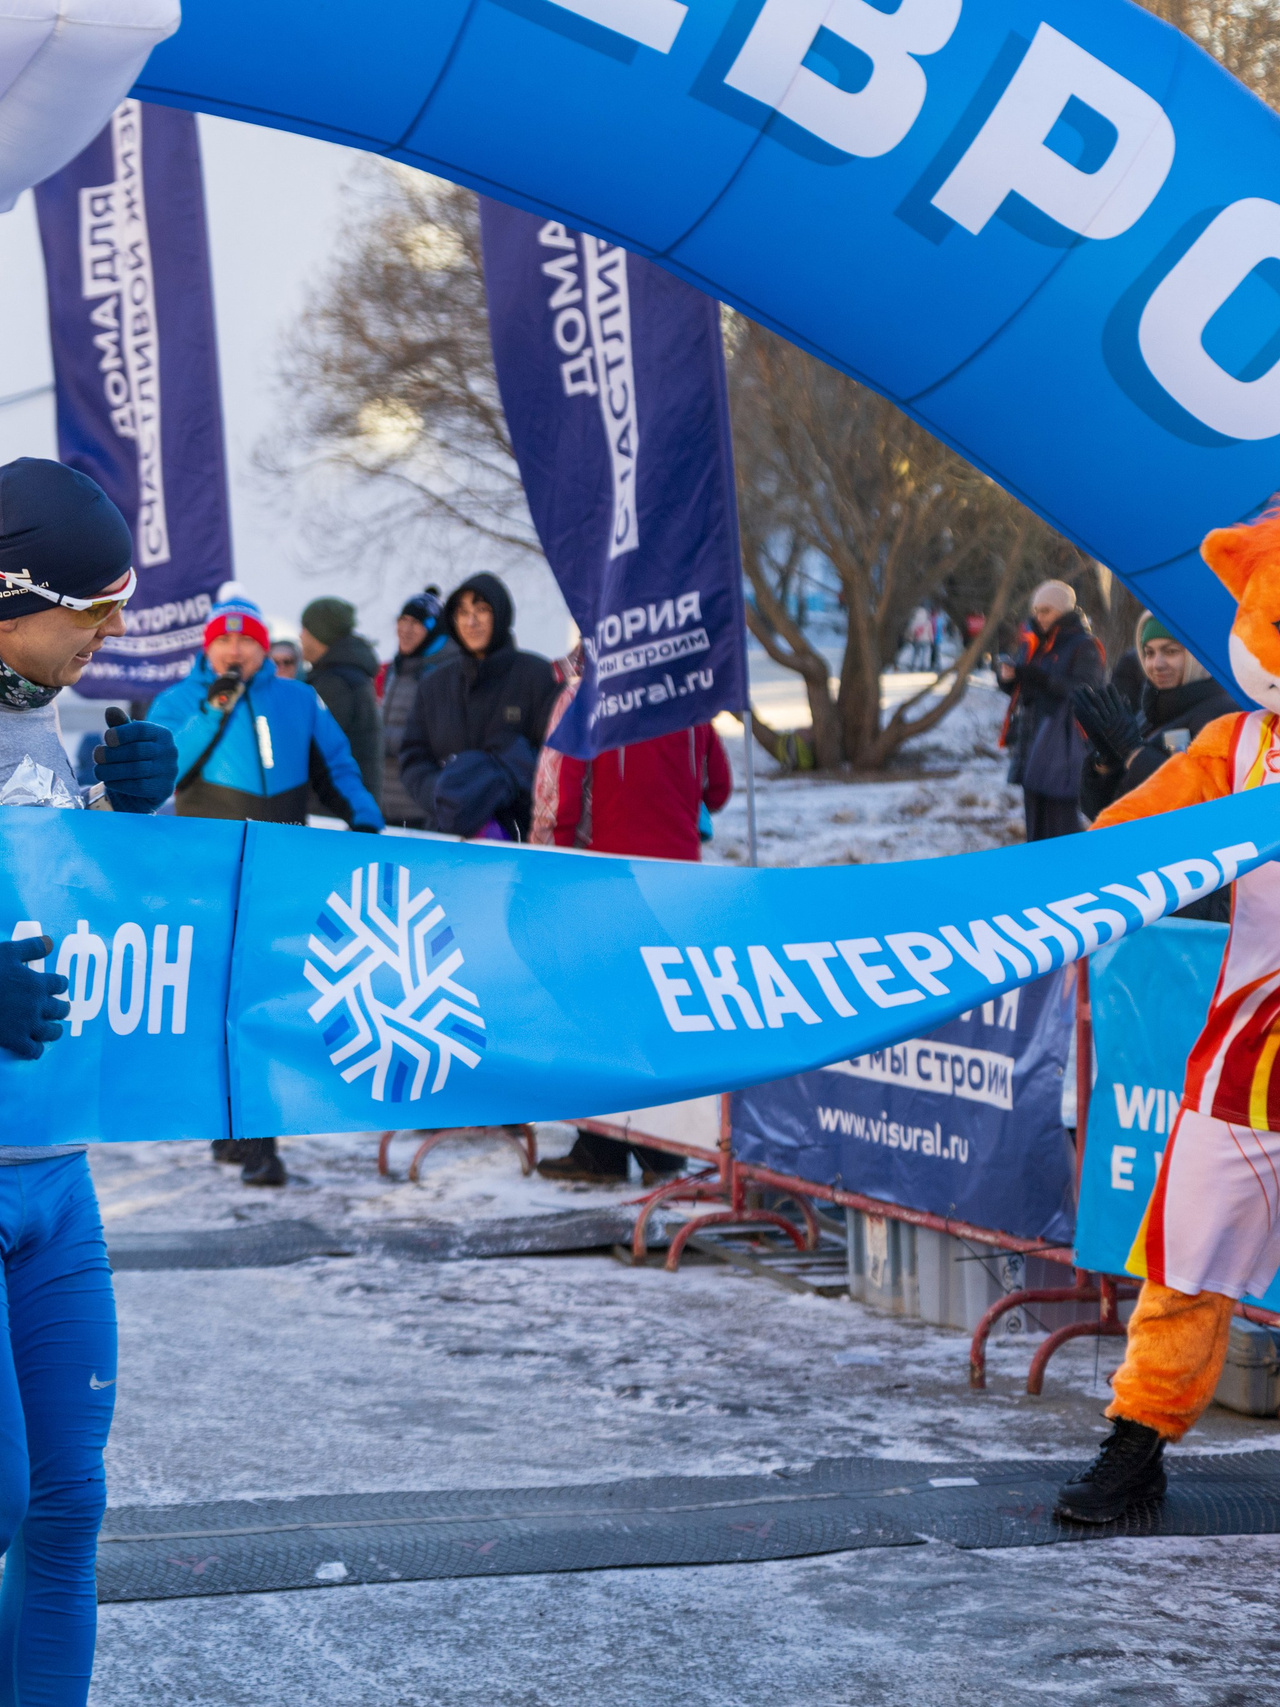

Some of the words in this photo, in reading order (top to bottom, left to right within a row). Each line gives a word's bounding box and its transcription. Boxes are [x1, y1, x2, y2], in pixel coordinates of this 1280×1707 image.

[89, 190, 120, 283] ДЛЯ
[544, 0, 1280, 440] ВРО
[538, 221, 598, 396] ДОМА
[90, 294, 138, 439] ДОМА
[596, 240, 633, 546] СЧАСТЛИ
[622, 633, 706, 666] строим
[589, 668, 714, 730] visural.ru
[916, 1048, 1008, 1098] строим
[817, 1105, 968, 1164] www.visural.ru
